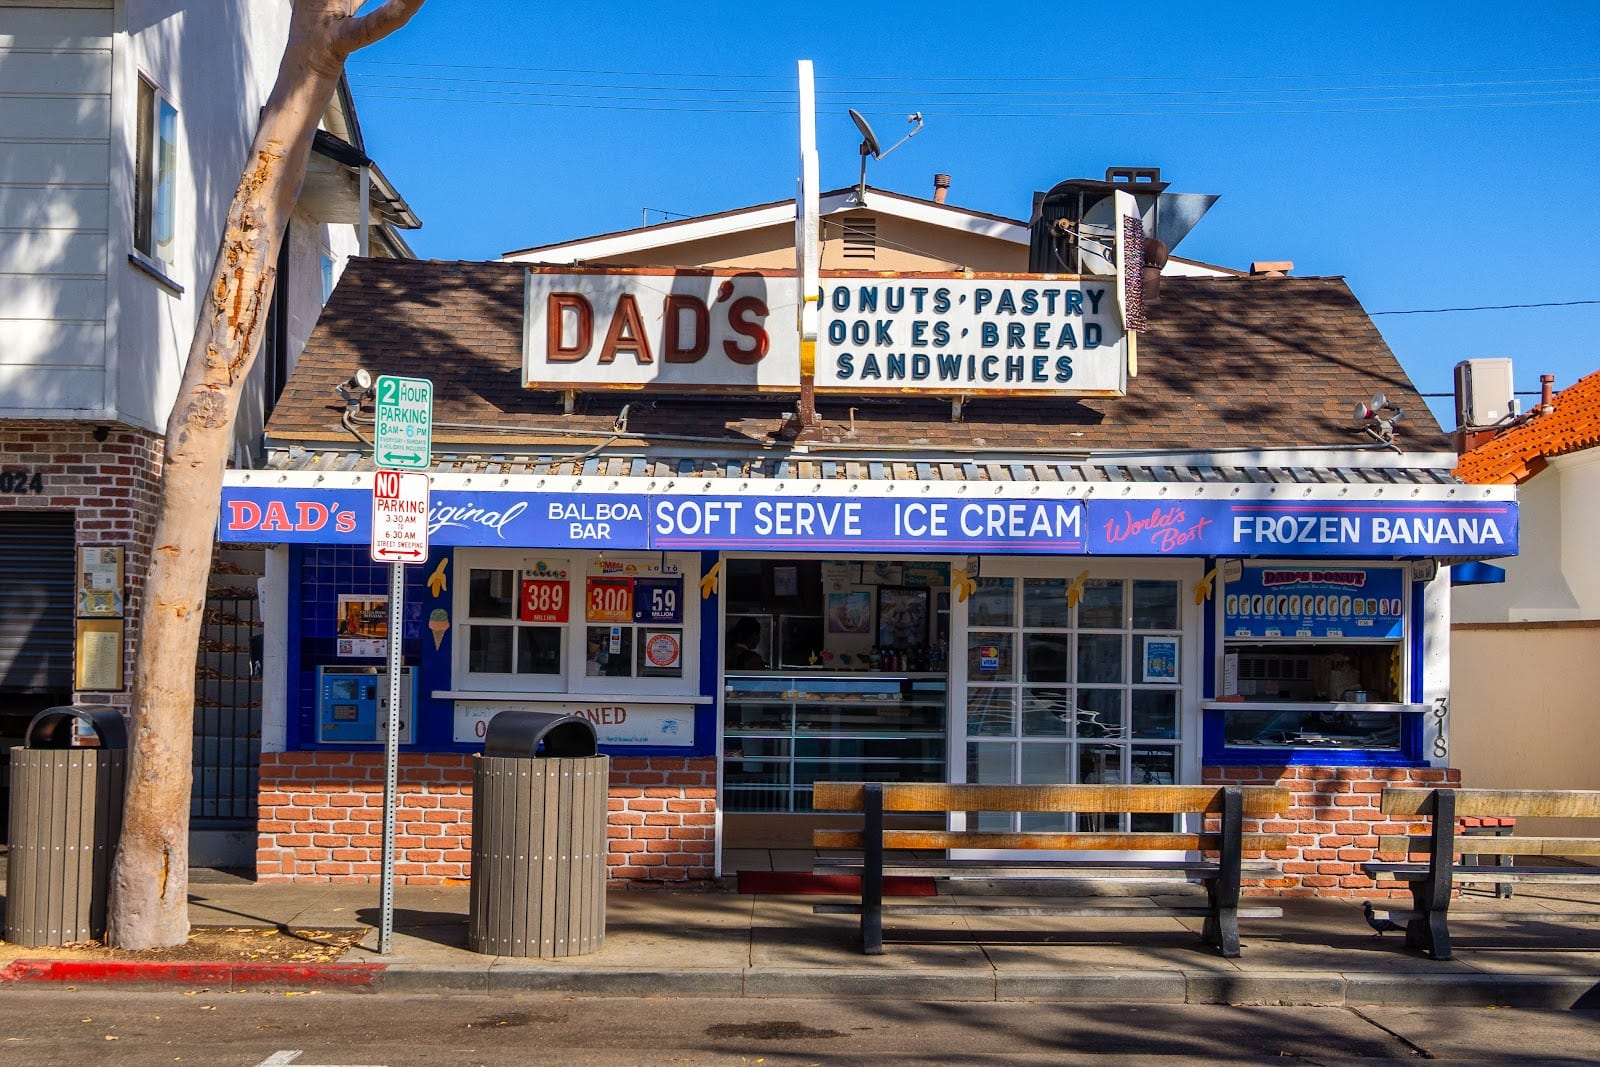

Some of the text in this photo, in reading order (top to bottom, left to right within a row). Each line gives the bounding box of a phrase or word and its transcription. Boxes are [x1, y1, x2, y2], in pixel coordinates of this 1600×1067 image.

[973, 288, 1105, 316] PASTRY
[546, 280, 770, 365] DAD'S
[981, 321, 1103, 349] BREAD
[836, 353, 1074, 382] SANDWICHES
[382, 380, 428, 404] 2 HOUR
[380, 407, 427, 425] PARKING
[406, 425, 414, 438] 6
[376, 473, 398, 498] NO
[377, 499, 425, 514] PARKING
[404, 515, 416, 523] AM
[548, 502, 643, 521] BALBOA
[428, 501, 529, 540] iginal
[569, 522, 612, 540] BAR
[655, 501, 1081, 538] SOFT SERVE ICE CREAM
[1104, 507, 1186, 544] World's
[1233, 515, 1504, 545] FROZEN BANANA
[377, 540, 424, 549] STREET SWEEPING
[1150, 516, 1213, 552] Best
[1311, 572, 1367, 586] DONUT
[527, 584, 563, 611] 389
[592, 587, 628, 611] 300
[652, 588, 676, 611] 59
[1434, 697, 1447, 758] 318
